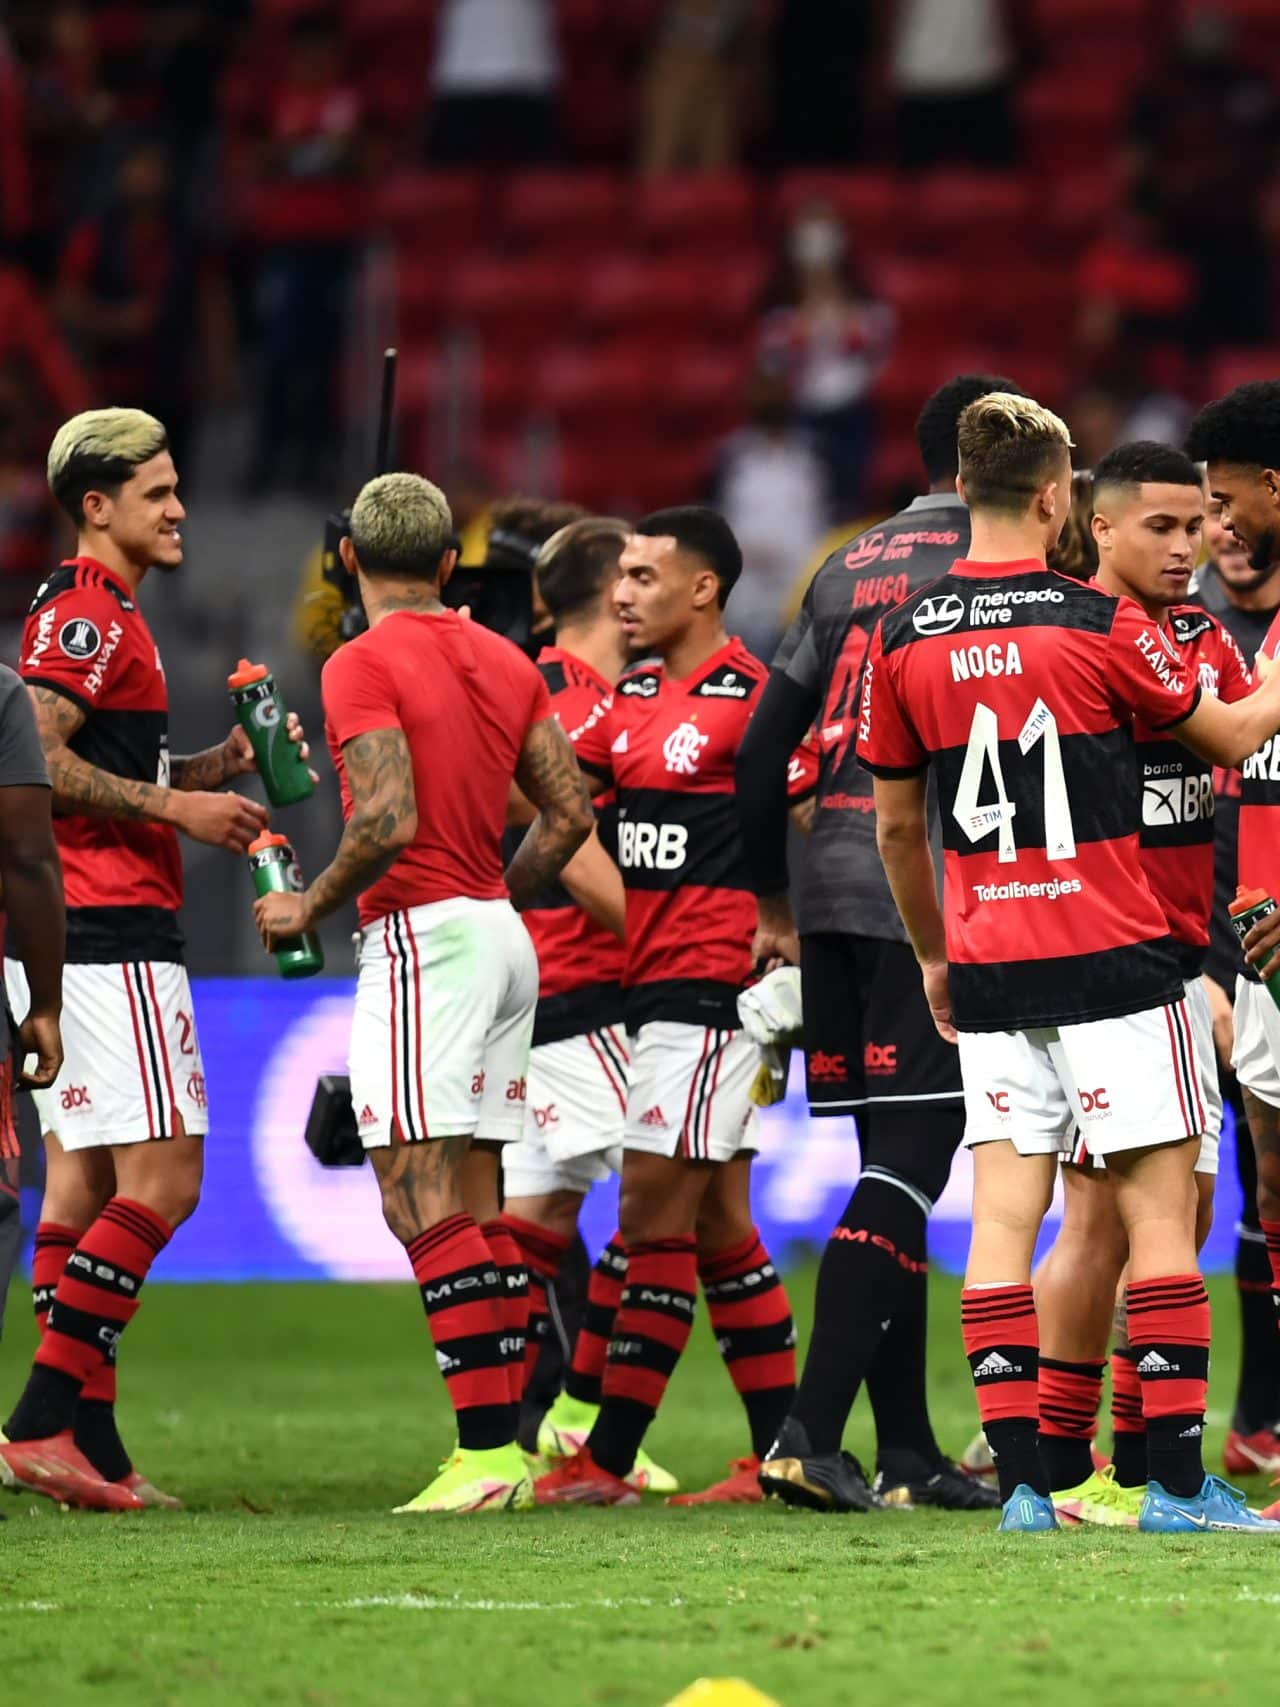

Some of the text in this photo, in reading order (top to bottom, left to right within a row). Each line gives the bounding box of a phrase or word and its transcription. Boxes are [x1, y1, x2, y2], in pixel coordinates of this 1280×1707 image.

[888, 530, 958, 546] mercado
[882, 545, 913, 562] livre
[853, 573, 909, 608] HUGO
[971, 588, 1064, 608] mercado
[969, 605, 1012, 626] livre
[84, 620, 123, 695] HAVAN
[950, 642, 1023, 683] NOGA
[1134, 631, 1186, 695] HAVAN
[859, 657, 873, 742] HAVAN
[1031, 708, 1049, 731] TIM
[952, 696, 1077, 864] 41
[1143, 762, 1183, 776] banco
[983, 810, 1002, 826] TIM
[623, 821, 689, 870] BRB
[972, 878, 1082, 902] TotalEnergies
[1078, 1087, 1110, 1113] bc
[974, 1361, 1022, 1377] adidas
[1137, 1362, 1180, 1372] adidas
